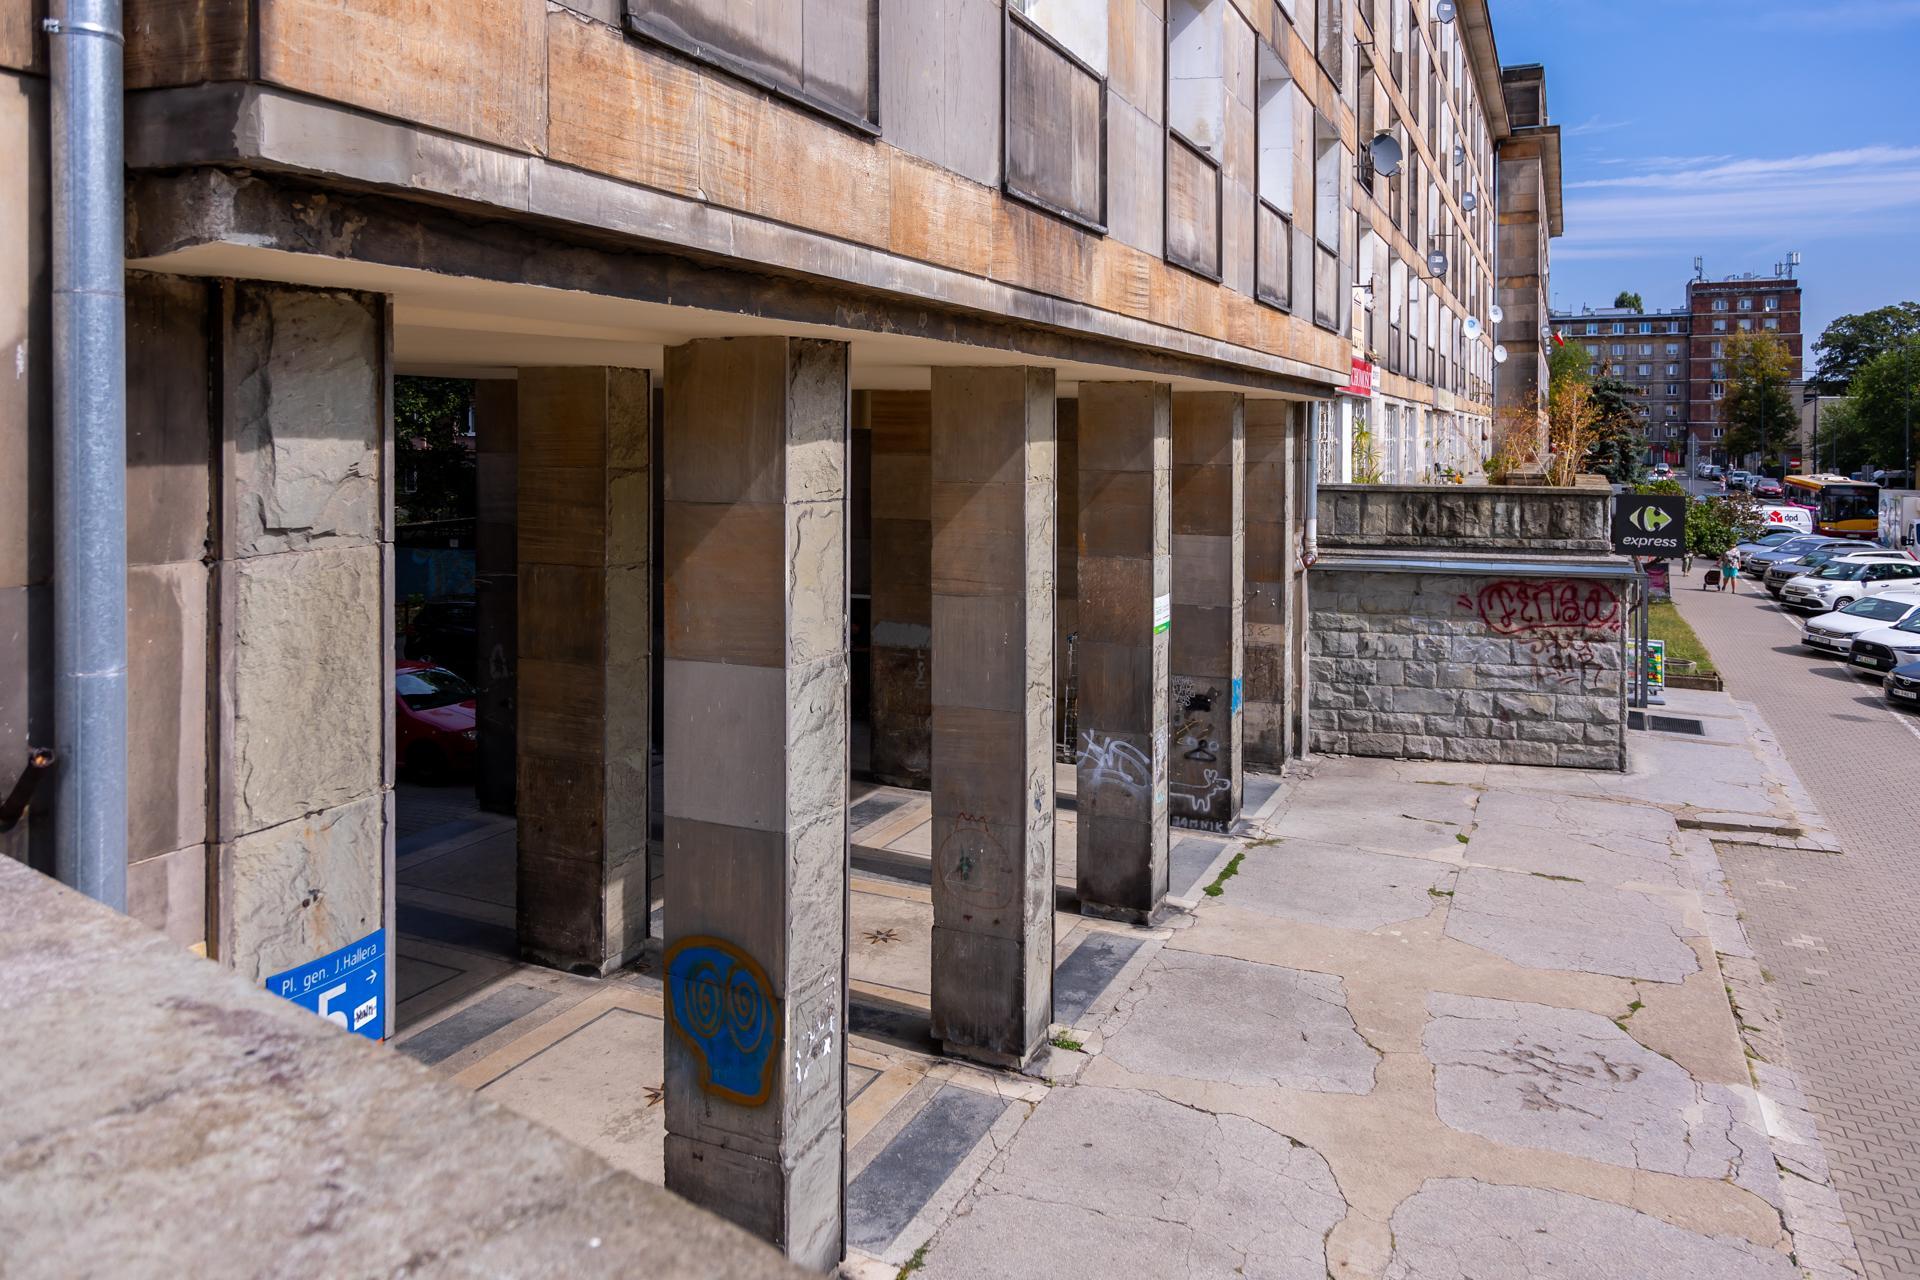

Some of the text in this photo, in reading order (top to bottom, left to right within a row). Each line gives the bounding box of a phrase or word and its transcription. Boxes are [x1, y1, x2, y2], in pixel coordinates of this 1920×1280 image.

[1784, 513, 1798, 522] dpd
[1622, 536, 1678, 548] express
[282, 977, 297, 995] Pl.
[303, 968, 329, 991] gen.
